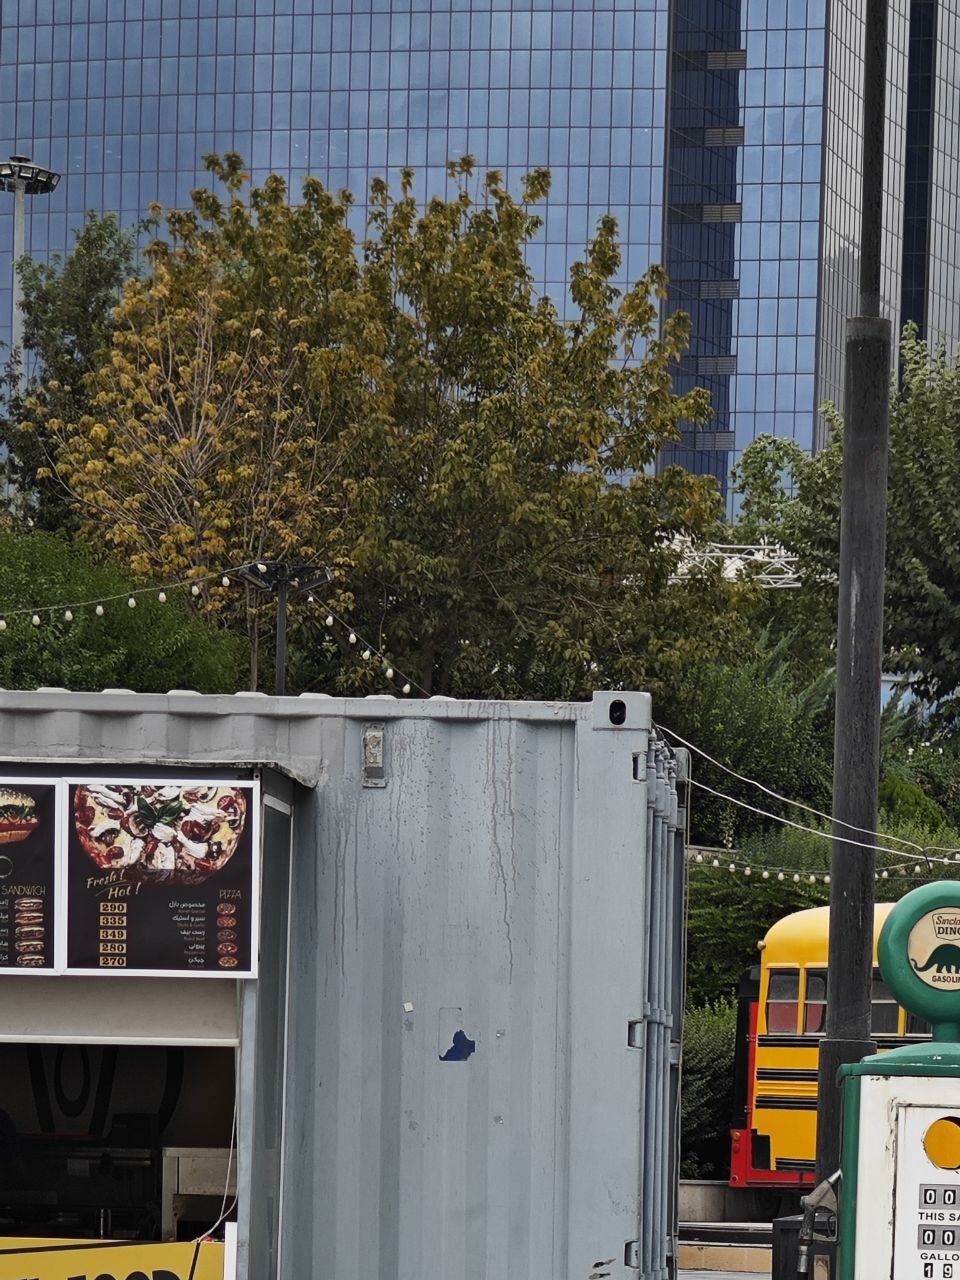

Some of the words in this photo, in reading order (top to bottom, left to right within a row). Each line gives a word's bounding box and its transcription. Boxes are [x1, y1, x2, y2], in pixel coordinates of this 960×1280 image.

[1, 885, 46, 896] SANDWICH
[218, 888, 242, 899] PIZZA
[102, 903, 124, 912] 290
[102, 916, 125, 925] 335
[102, 930, 124, 939] 349
[102, 943, 124, 952] 280
[102, 957, 125, 966] 270
[918, 1212, 945, 1221] THIS
